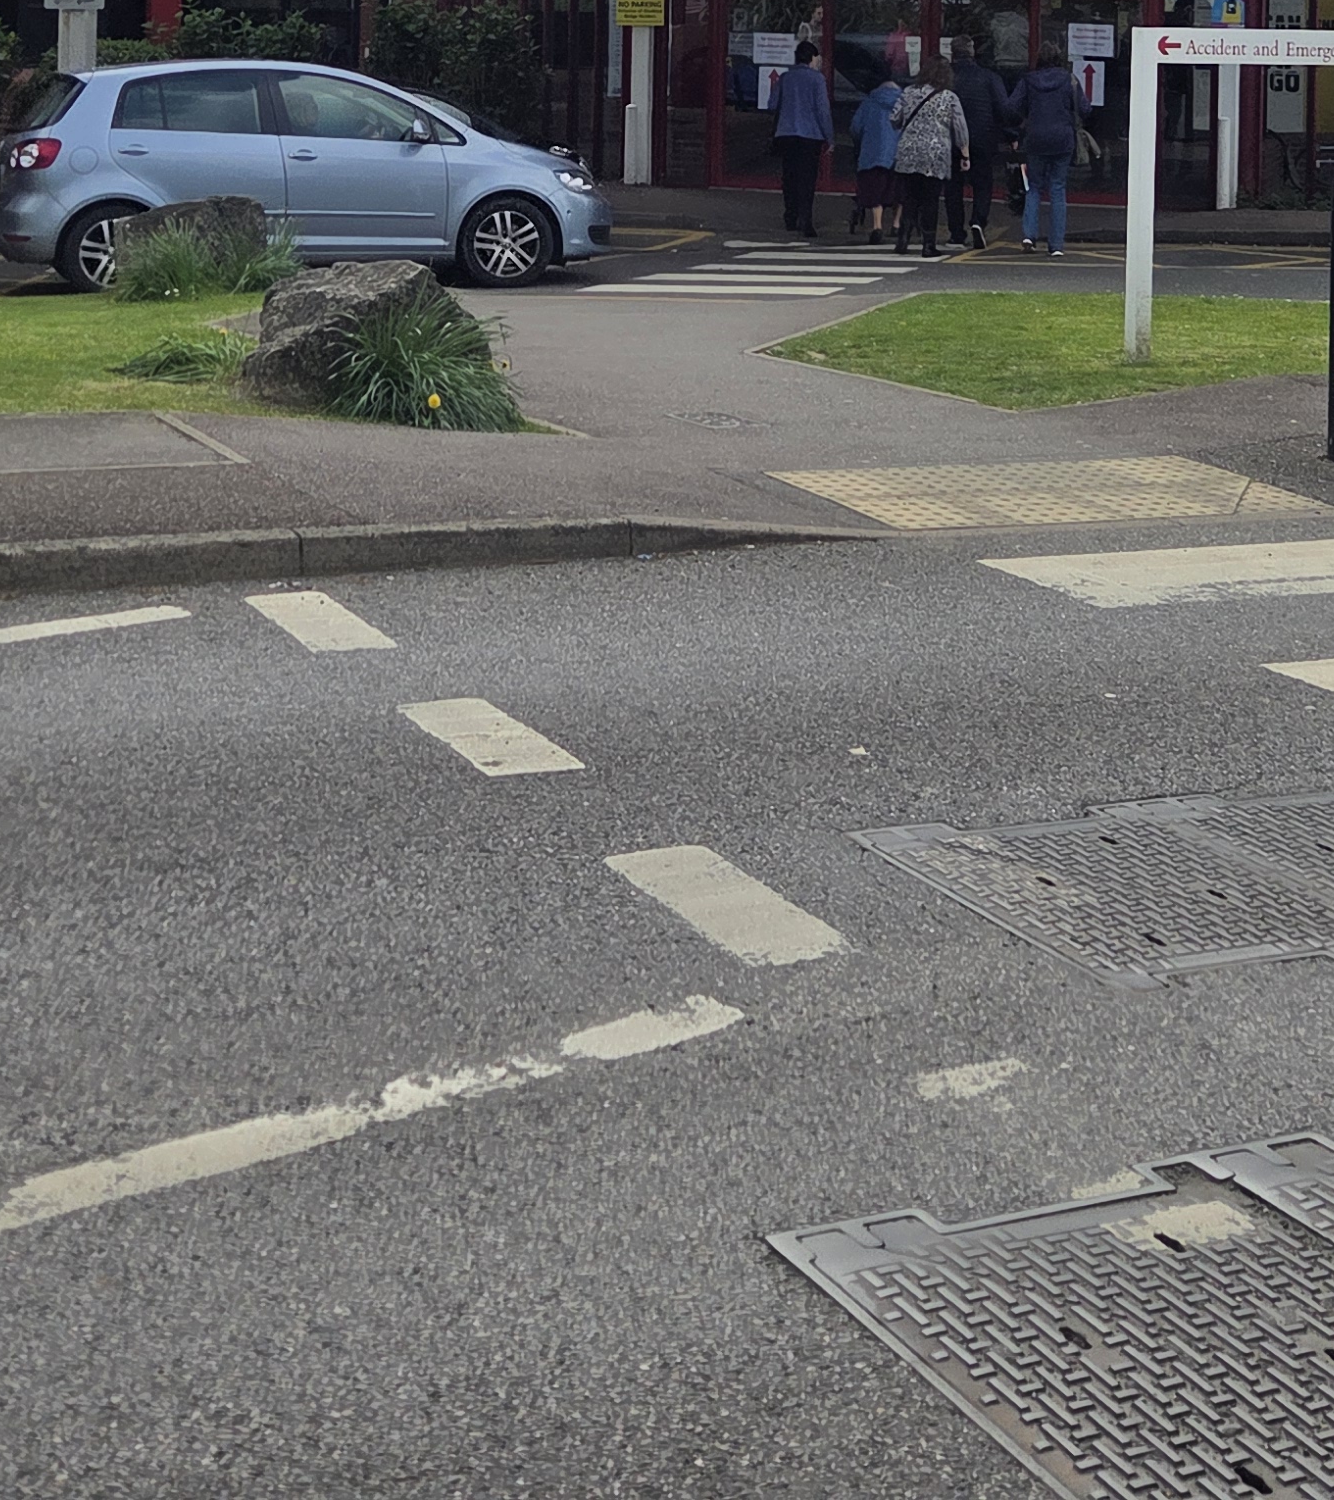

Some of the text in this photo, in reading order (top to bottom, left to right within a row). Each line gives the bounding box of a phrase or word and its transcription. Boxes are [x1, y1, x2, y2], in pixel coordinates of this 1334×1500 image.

[1185, 38, 1247, 56] Accident
[1253, 39, 1280, 56] and
[1270, 73, 1300, 92] GO
